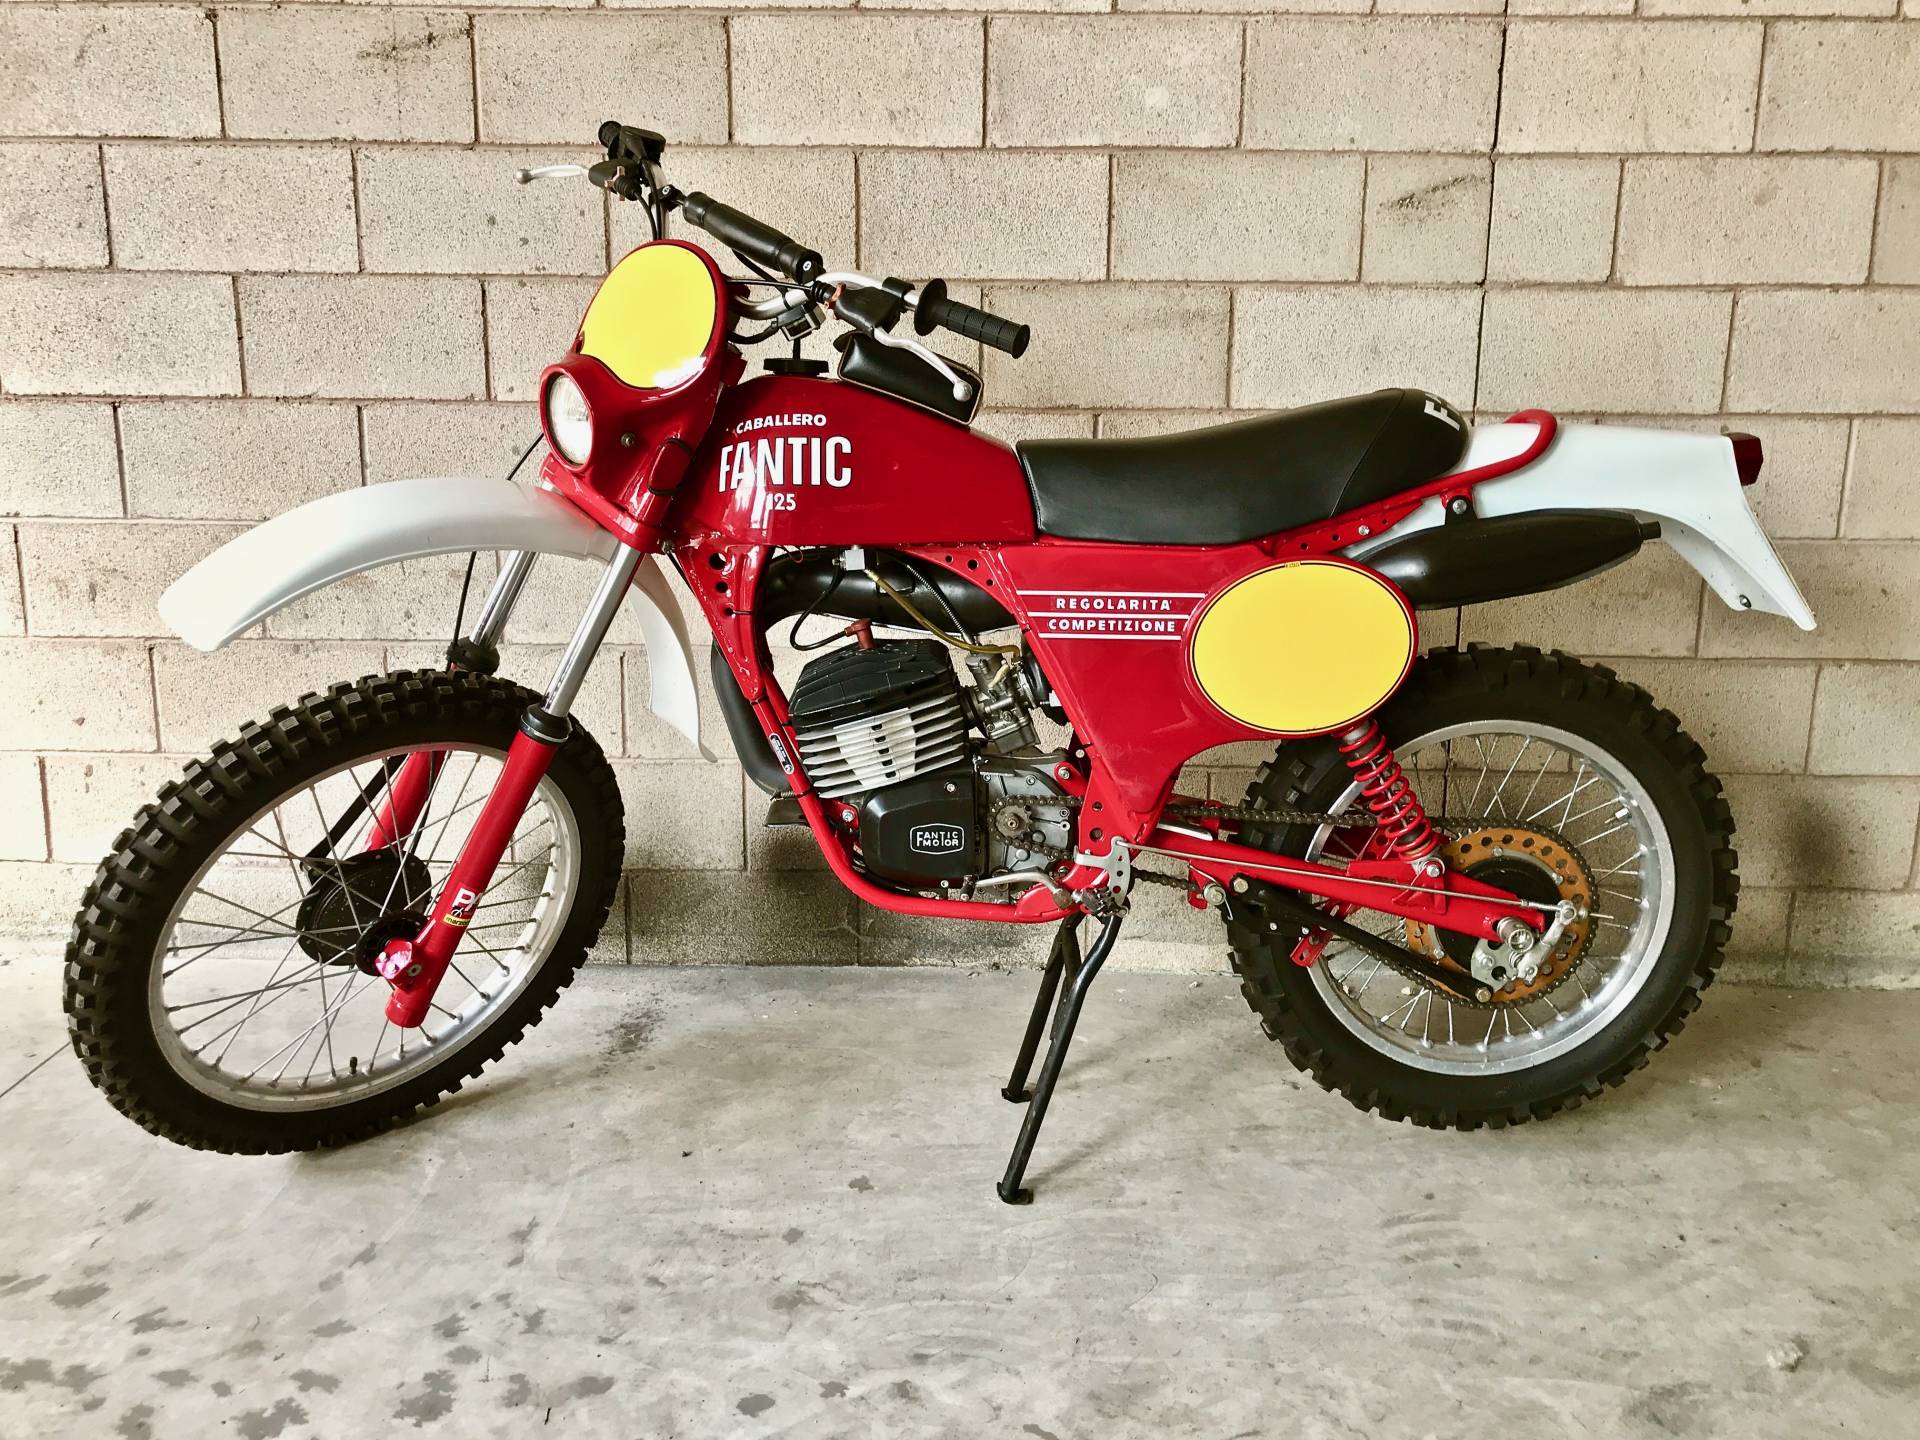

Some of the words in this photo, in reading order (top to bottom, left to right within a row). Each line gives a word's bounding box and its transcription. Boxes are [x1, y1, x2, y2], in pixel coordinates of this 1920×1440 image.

[736, 413, 827, 434] CABALLERO
[718, 435, 852, 493] FANTIC
[766, 493, 797, 511] 125
[1048, 618, 1176, 632] COMPETIZIONE
[916, 831, 959, 846] FANTIC
[922, 837, 959, 847] MOTOR
